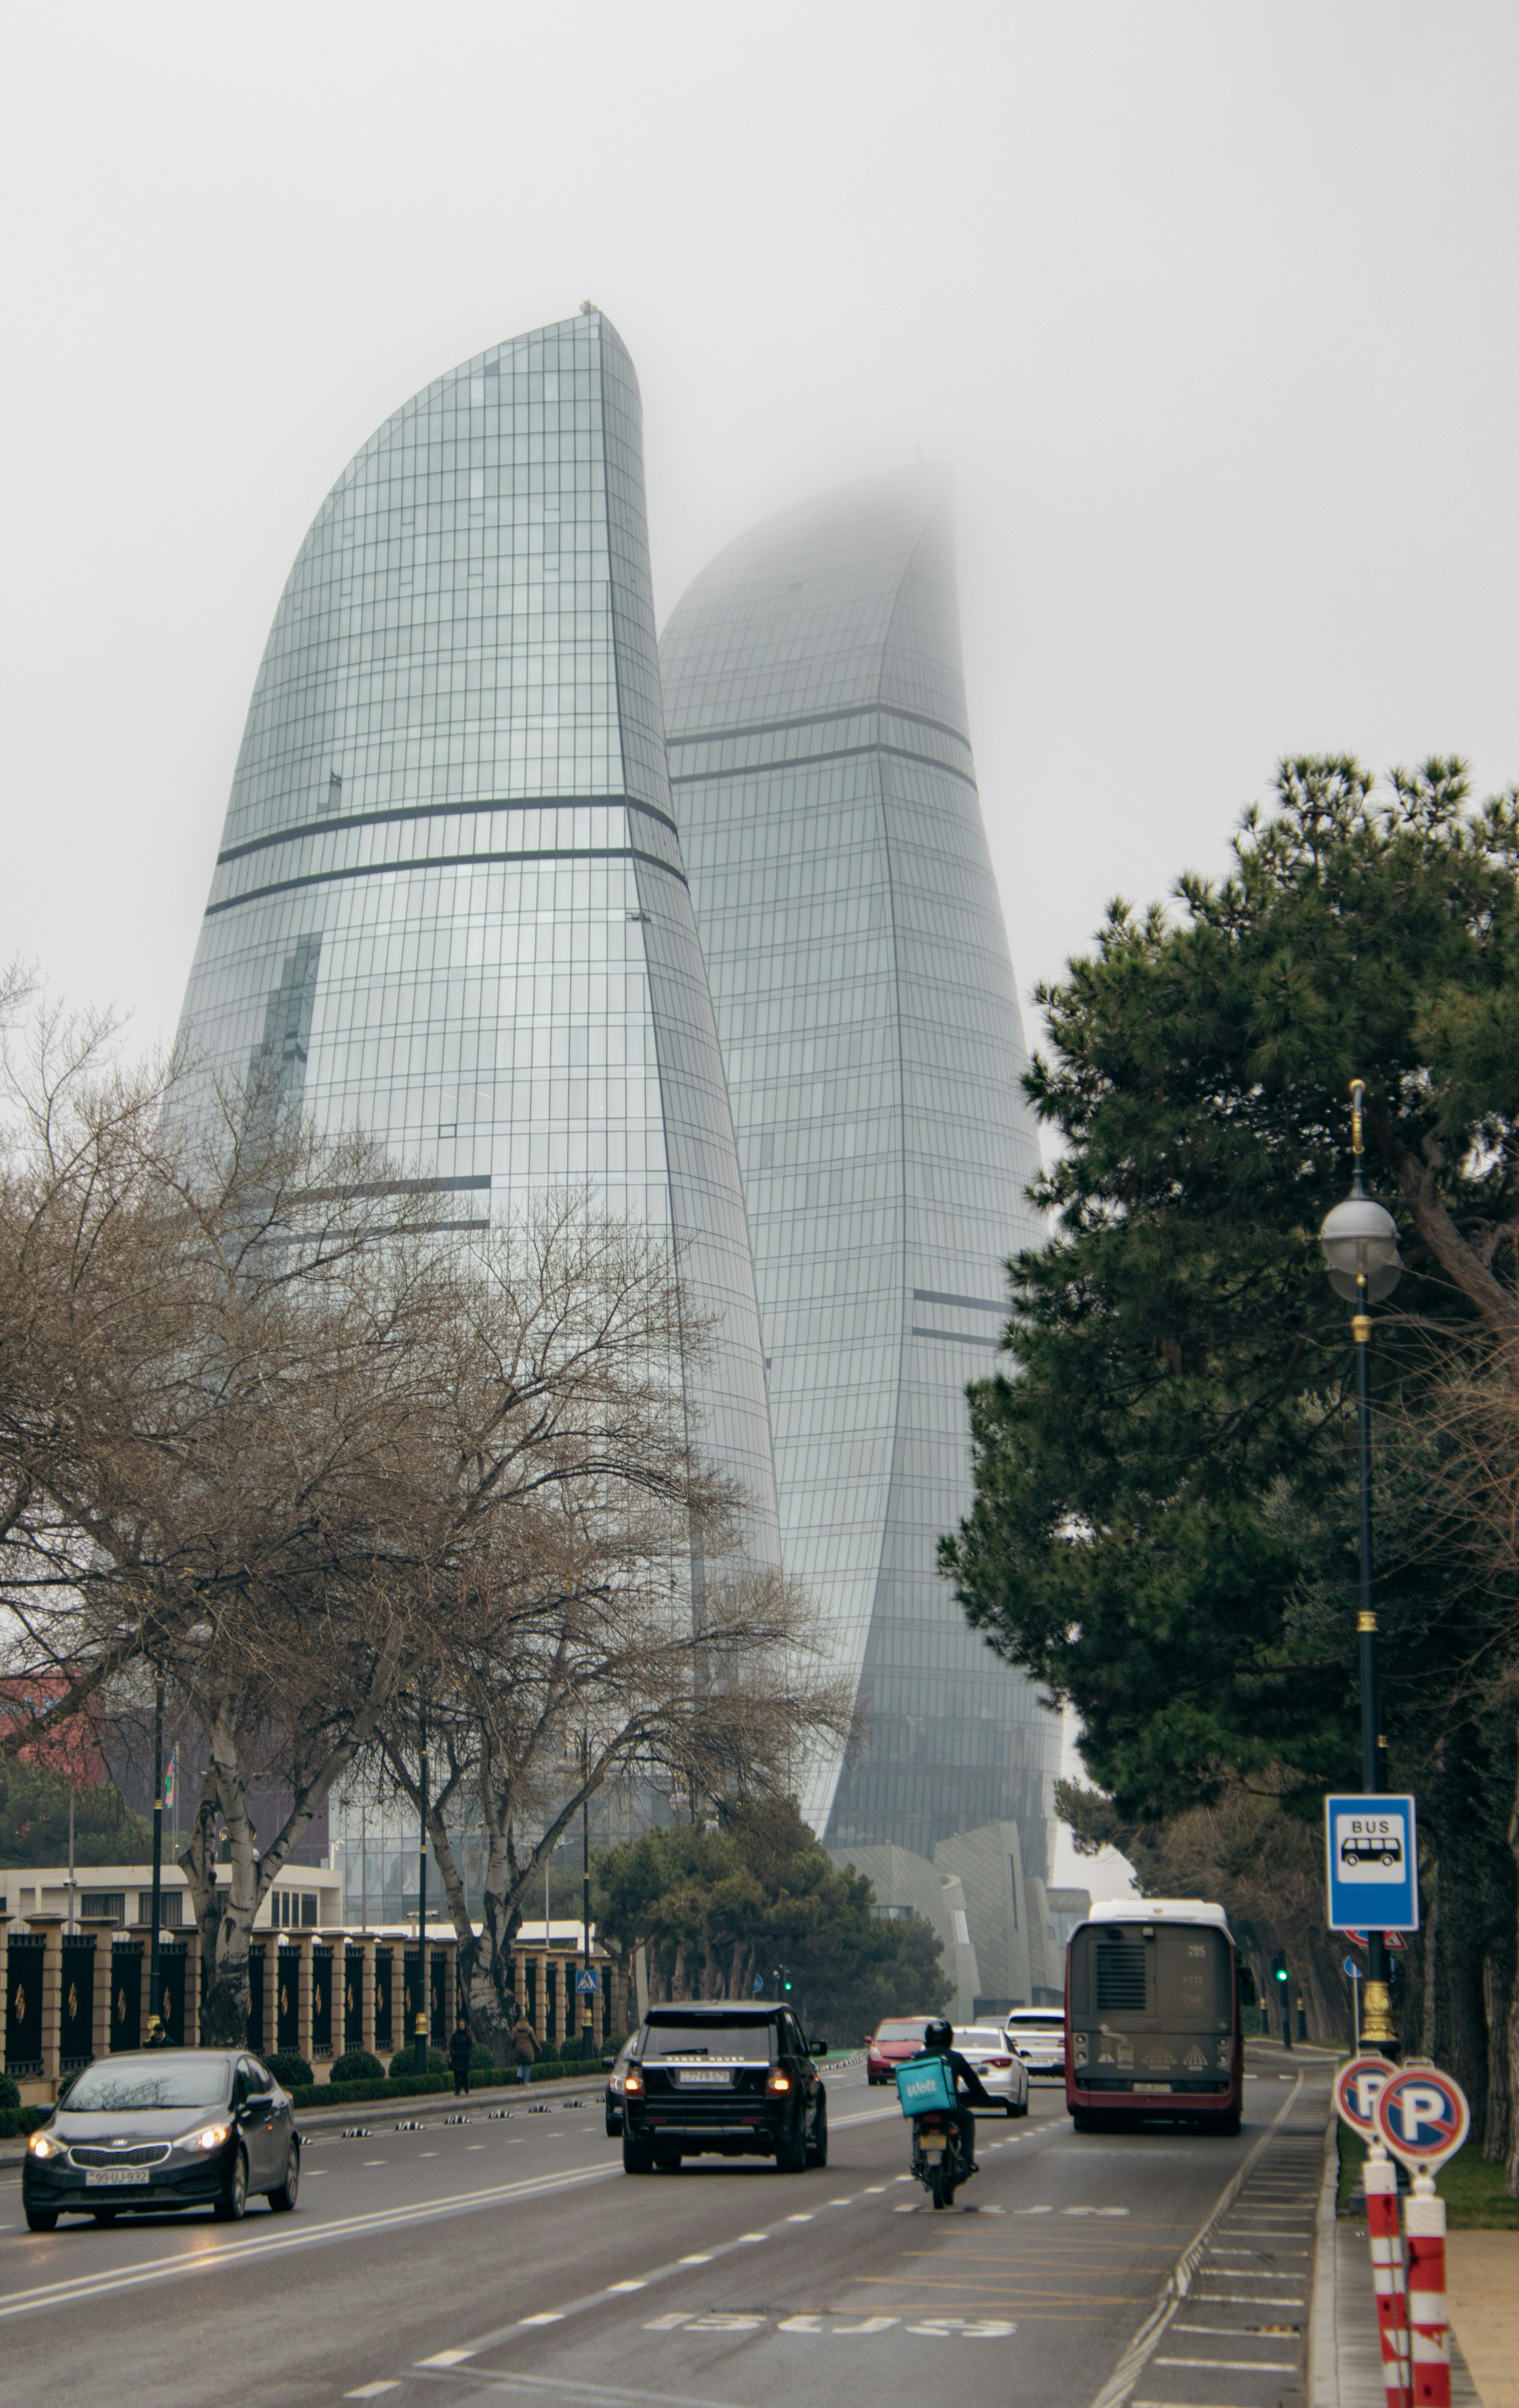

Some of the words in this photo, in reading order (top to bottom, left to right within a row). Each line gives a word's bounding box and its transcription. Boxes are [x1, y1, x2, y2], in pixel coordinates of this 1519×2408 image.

[1352, 1821, 1390, 1834] BUS
[906, 2079, 937, 2097] Wolt
[1402, 2089, 1445, 2141] P
[642, 2312, 1019, 2338] BUS
